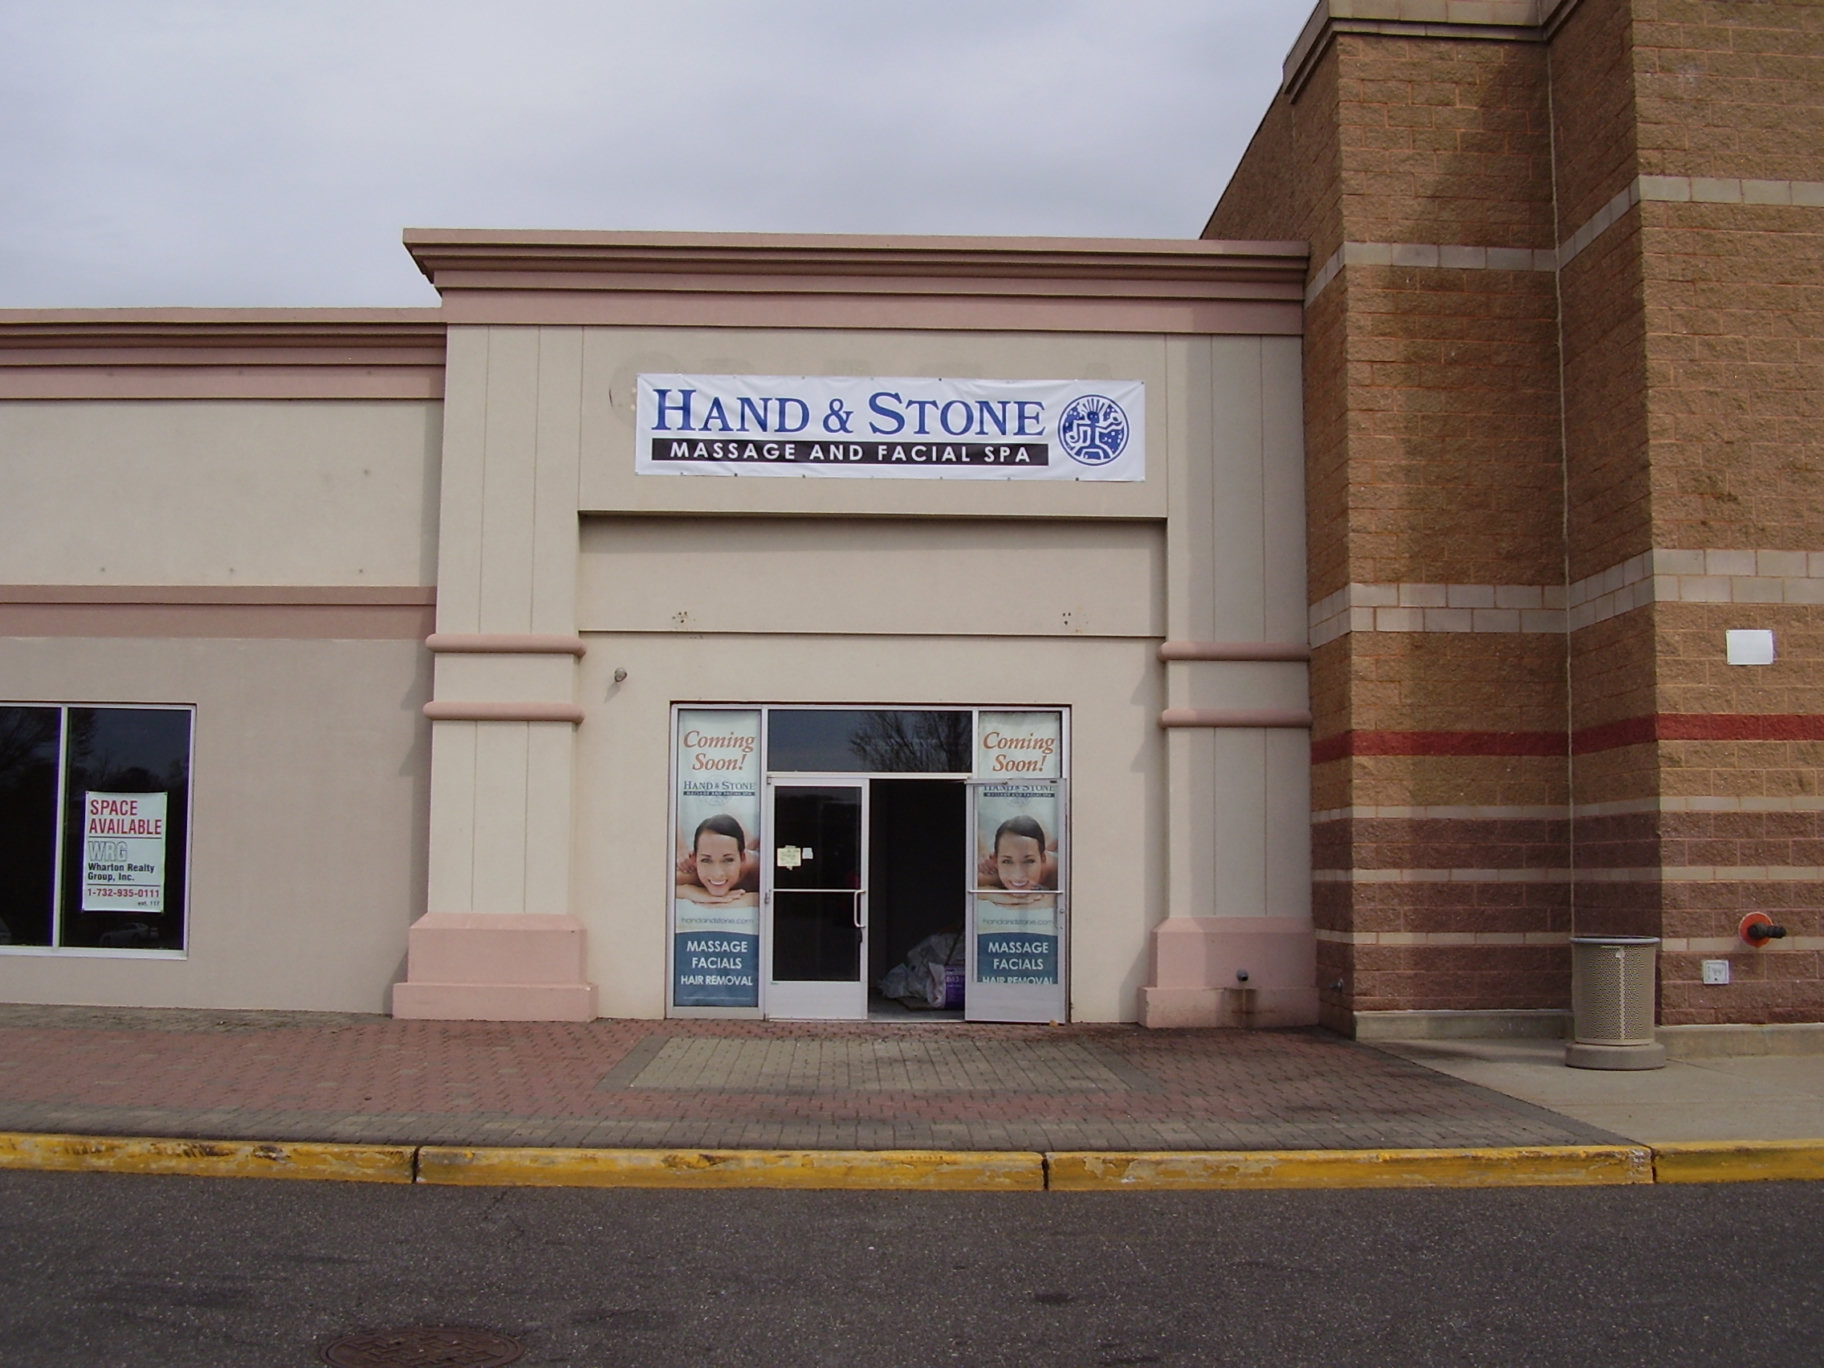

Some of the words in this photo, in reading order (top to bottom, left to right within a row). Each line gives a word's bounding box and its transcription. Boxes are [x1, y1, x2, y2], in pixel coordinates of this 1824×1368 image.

[651, 388, 811, 433] HAND
[822, 398, 854, 434] &
[868, 391, 1047, 437] STONE
[670, 441, 797, 460] MASSAGE
[809, 444, 864, 461] AND
[877, 444, 971, 463] FACIAL
[983, 445, 1031, 464] SPA
[683, 730, 756, 753] Coming
[983, 731, 1056, 755] Coming
[692, 752, 748, 771] Soon!
[992, 753, 1048, 772] Soon!
[683, 780, 714, 790] HAND
[722, 780, 755, 790] STONE
[90, 799, 138, 816] SPACE
[88, 818, 162, 835] AVAILABLE
[87, 840, 128, 862] WRG
[88, 862, 125, 872] Wharton
[127, 863, 155, 874] Realty
[87, 871, 116, 882] Group,
[118, 873, 135, 882] Inc.
[87, 888, 160, 898] 1-732-935-0111
[686, 940, 748, 952] MASSAGE
[988, 942, 1049, 954] MASSAGE
[691, 957, 742, 969] FACIALS
[993, 958, 1044, 970] FACIALS
[680, 975, 704, 985] HAIR
[705, 975, 753, 986] REMOVAL
